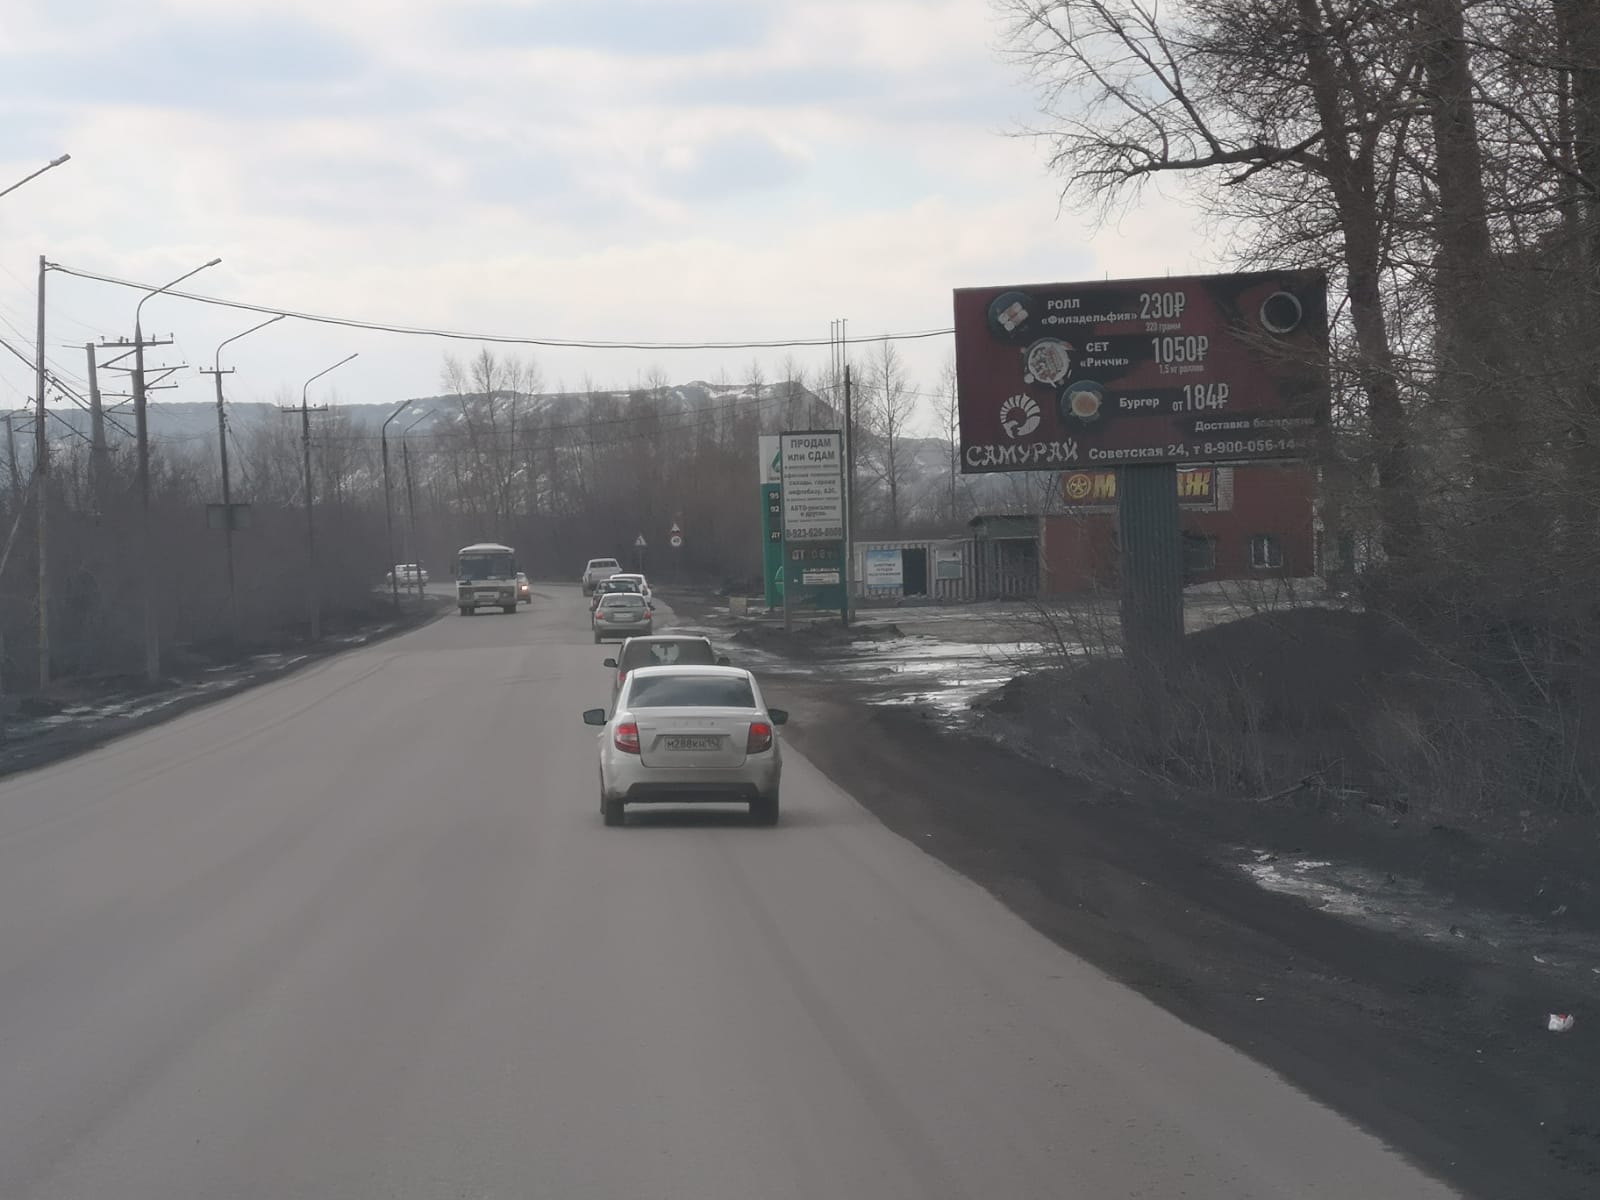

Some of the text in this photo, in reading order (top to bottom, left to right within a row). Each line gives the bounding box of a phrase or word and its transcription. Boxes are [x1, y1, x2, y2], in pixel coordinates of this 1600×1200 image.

[1047, 298, 1080, 310] РОЛЛ
[1042, 311, 1138, 325] «Филадельфия»
[1086, 342, 1109, 352] СЕТ
[1080, 356, 1129, 368] «Риччи»
[1119, 395, 1160, 410] Бургер
[1172, 401, 1184, 412] от
[1195, 418, 1251, 432] Доставка
[790, 437, 832, 449] ПРОДАМ
[787, 450, 835, 463] или СДАМ
[966, 436, 1079, 467] САМУРАЙ
[1088, 445, 1164, 460] Советская
[1167, 443, 1190, 459] 24,
